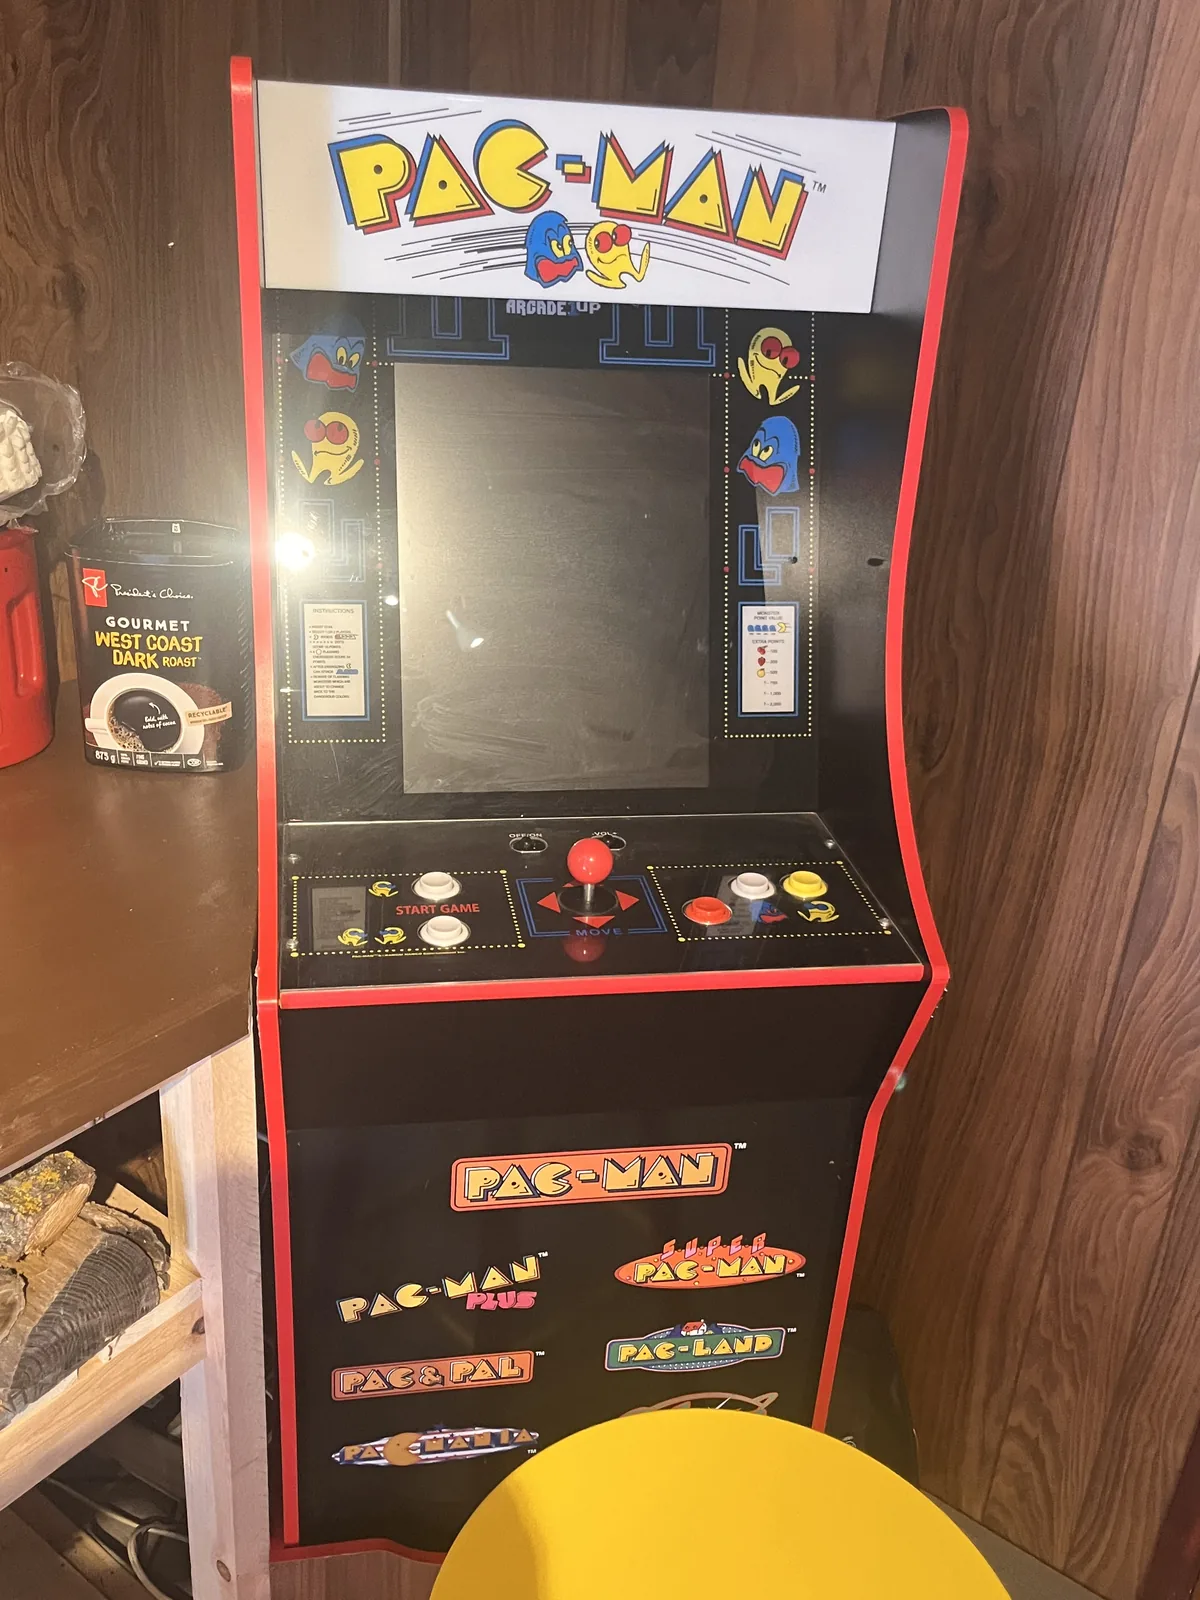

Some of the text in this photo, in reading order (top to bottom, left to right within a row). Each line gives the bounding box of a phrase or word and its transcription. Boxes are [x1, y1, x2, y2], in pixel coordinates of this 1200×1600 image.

[327, 119, 809, 260] PAC-MAN
[105, 616, 190, 632] GOURMET
[95, 630, 203, 652] WEST COAST
[112, 649, 197, 669] DARK ROAST
[395, 903, 480, 916] START GAME
[575, 927, 623, 937] MOVE
[463, 1152, 719, 1203] PAC-MAN
[660, 1232, 767, 1261] SUPER
[633, 1253, 787, 1284] PAC-MAN
[335, 1254, 541, 1324] PAC-MAN
[465, 1290, 538, 1311] PLUS
[617, 1333, 774, 1364] PAC-LAND
[339, 1366, 415, 1395] PAC
[418, 1365, 445, 1387] &
[449, 1355, 524, 1384] PAL
